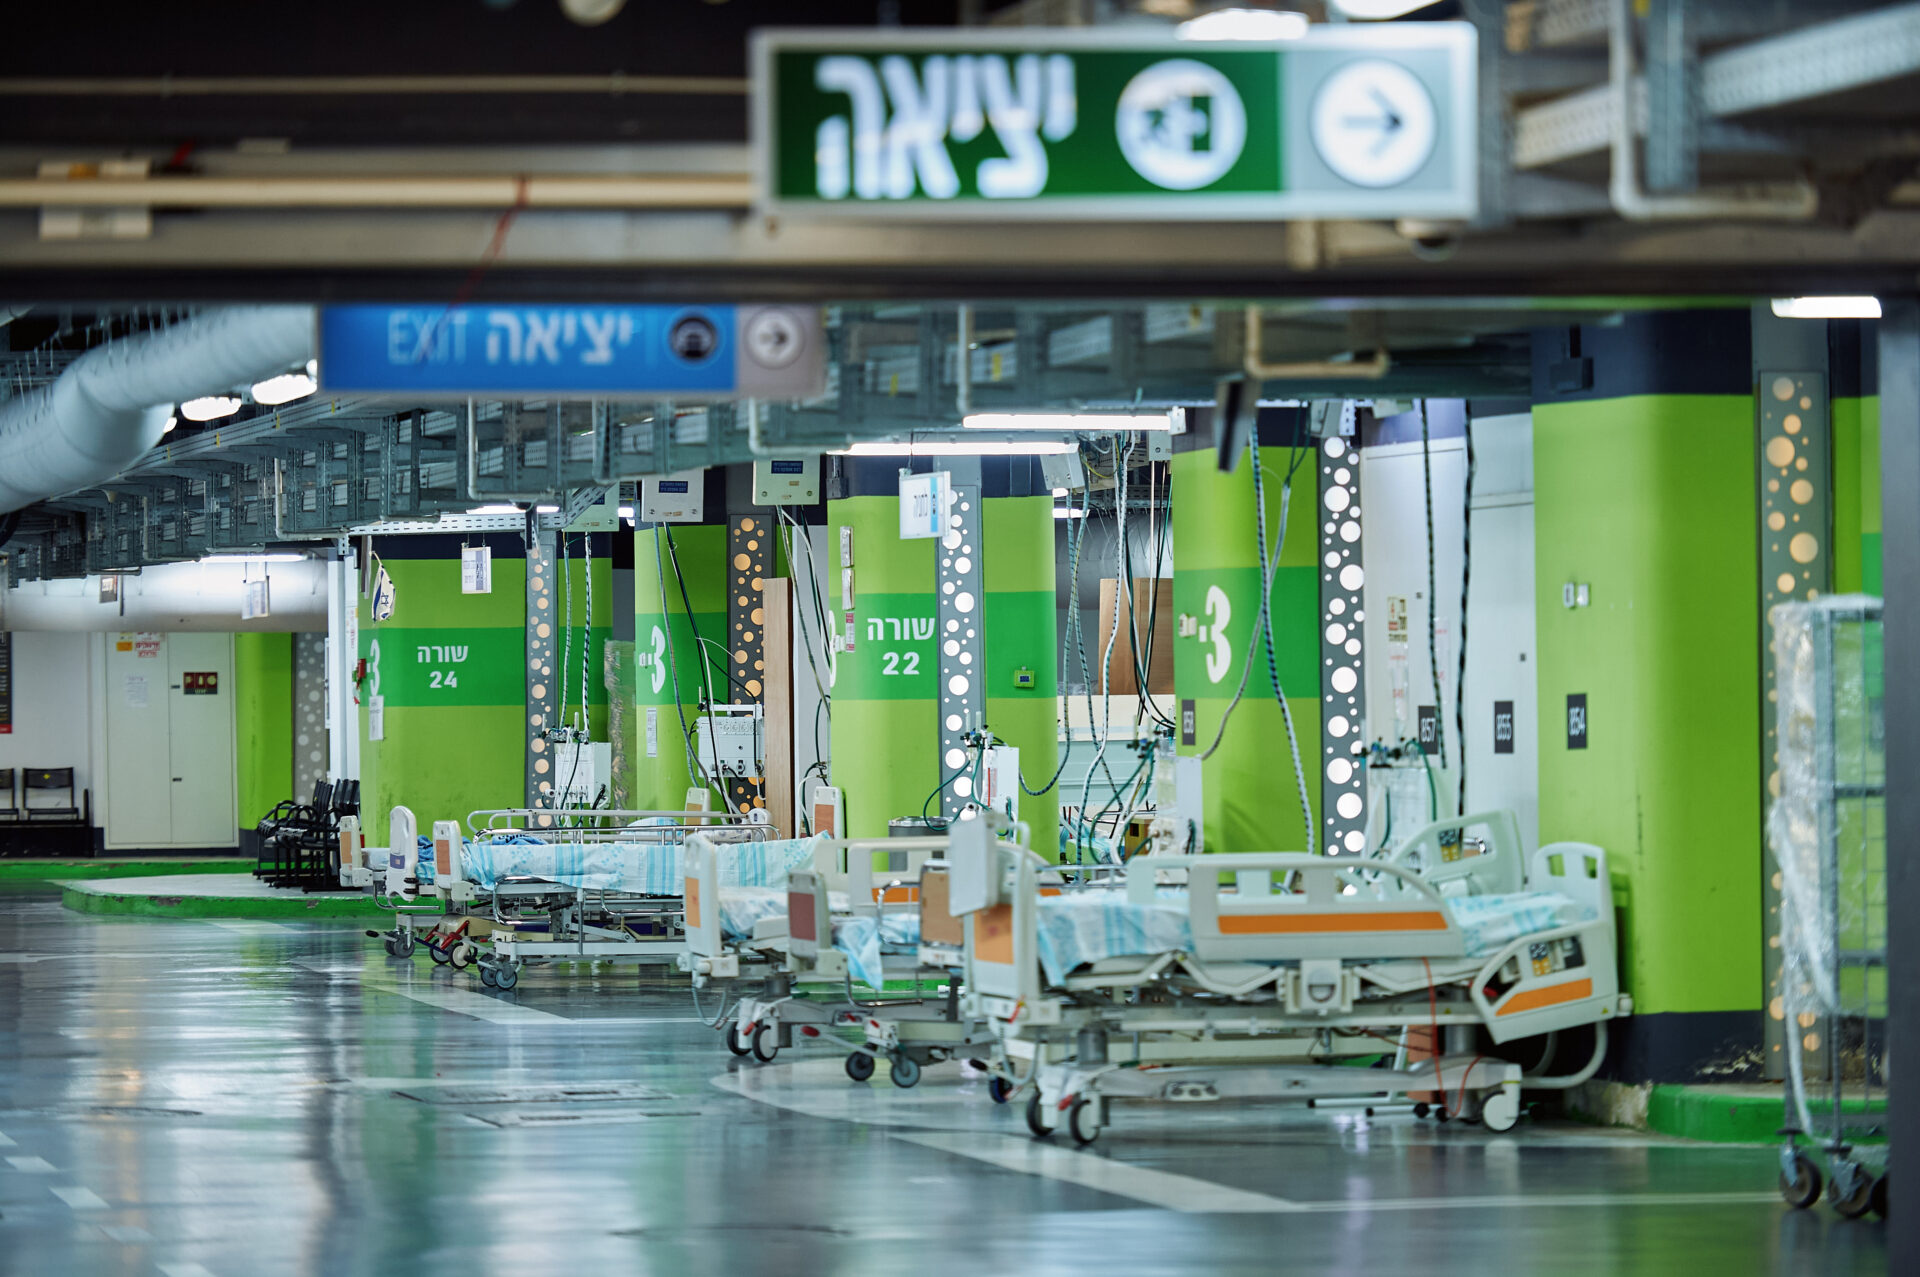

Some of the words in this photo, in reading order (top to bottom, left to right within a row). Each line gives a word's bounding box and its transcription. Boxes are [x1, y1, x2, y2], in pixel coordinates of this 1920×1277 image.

[814, 53, 1079, 200] יציאה
[387, 309, 470, 365] EXIT
[485, 309, 635, 366] יציאה
[867, 617, 936, 641] שורה
[417, 645, 469, 663] שורה
[881, 651, 920, 676] 22
[429, 671, 458, 689] 24
[1420, 717, 1436, 743] 857
[1568, 707, 1586, 736] 854
